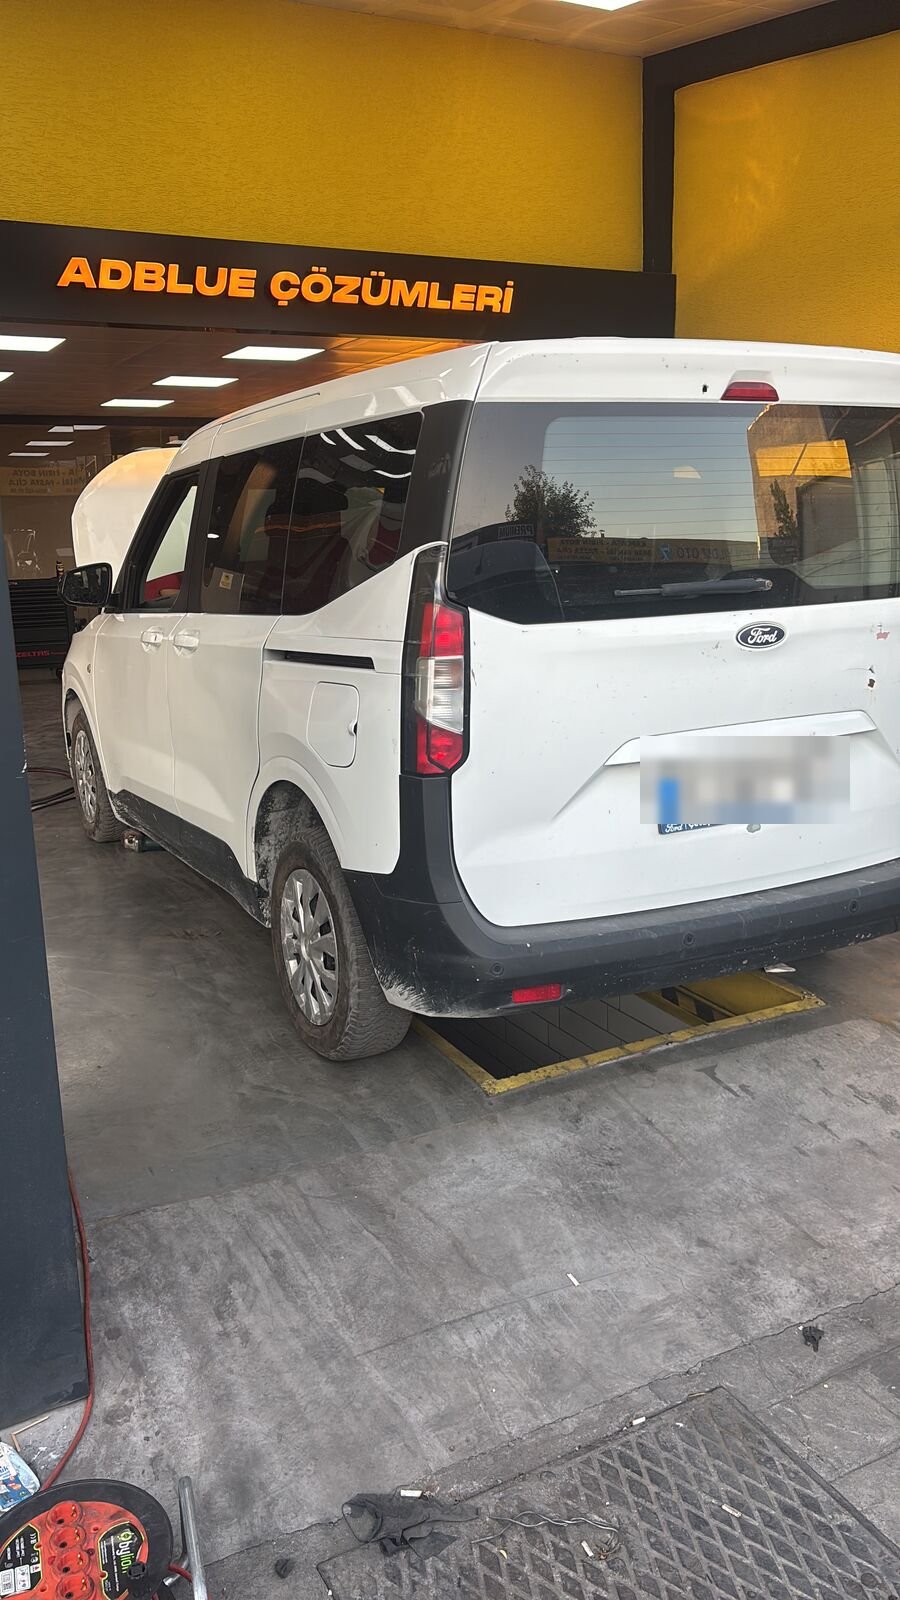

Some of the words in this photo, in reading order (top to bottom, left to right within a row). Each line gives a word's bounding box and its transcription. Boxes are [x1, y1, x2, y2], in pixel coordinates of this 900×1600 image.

[57, 256, 257, 299] ADBLUE
[270, 266, 515, 314] ÇÖZÜMLERİ
[747, 627, 778, 644] Ford
